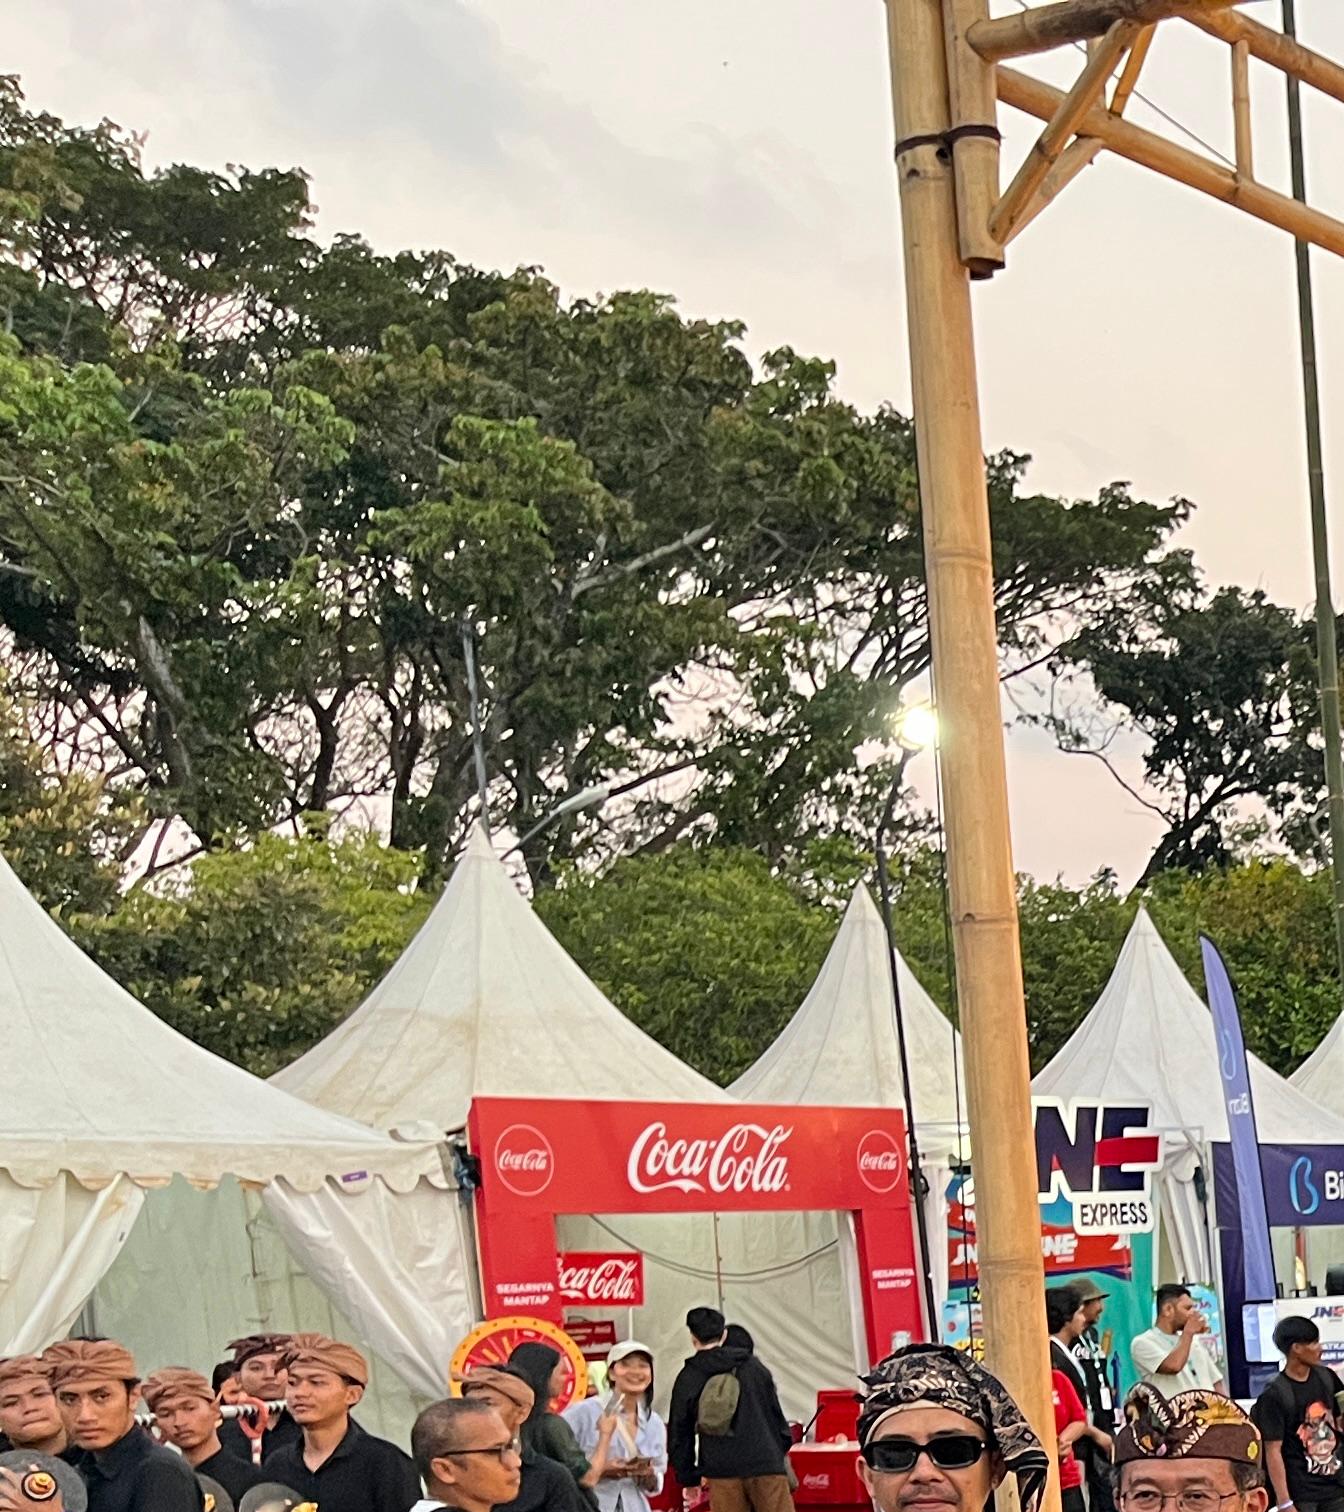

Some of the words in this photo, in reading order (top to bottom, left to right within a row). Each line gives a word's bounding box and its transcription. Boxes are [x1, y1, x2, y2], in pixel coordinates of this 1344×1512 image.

[627, 1122, 793, 1193] Coca-Cola
[1035, 1106, 1159, 1192] NE
[500, 1149, 548, 1170] Coca-Cola
[860, 1152, 897, 1170] Coca-Cola
[1080, 1202, 1147, 1226] EXPRESS
[496, 1282, 554, 1295] SEGARNYA
[504, 1295, 550, 1306] MANTAP
[1310, 1305, 1344, 1320] JNE
